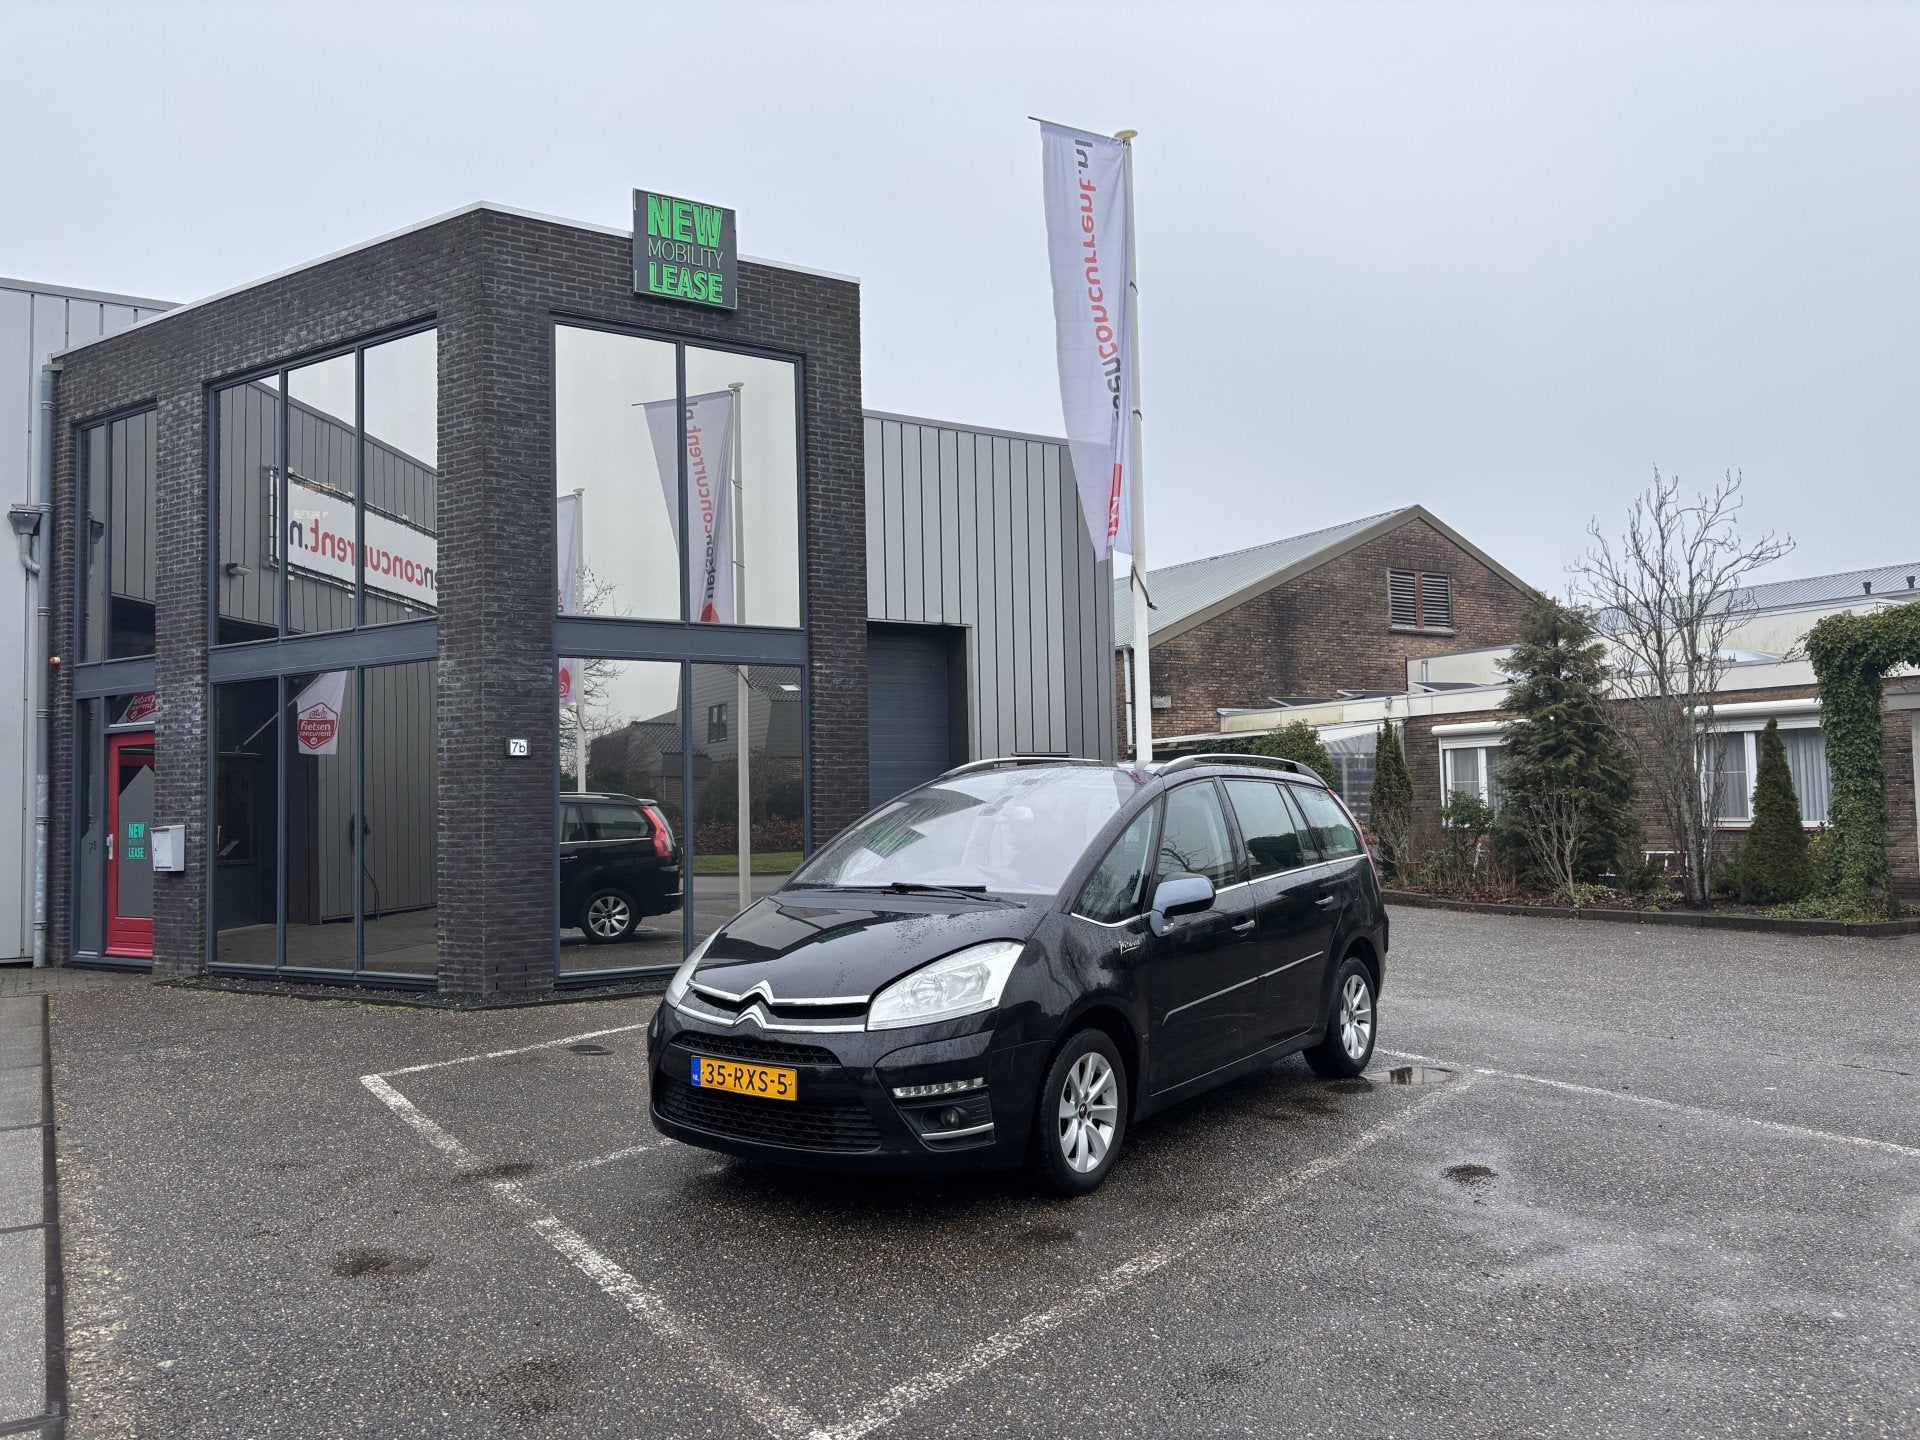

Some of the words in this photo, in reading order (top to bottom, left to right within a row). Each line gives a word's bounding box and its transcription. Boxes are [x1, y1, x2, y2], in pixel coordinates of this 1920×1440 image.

[648, 194, 722, 248] NEW
[648, 238, 723, 270] MOBILITY
[649, 262, 722, 304] LEASE
[512, 741, 526, 754] 7b
[128, 823, 145, 838] NEW
[128, 846, 145, 858] LEASE
[705, 1063, 788, 1095] 35-RXS-5
